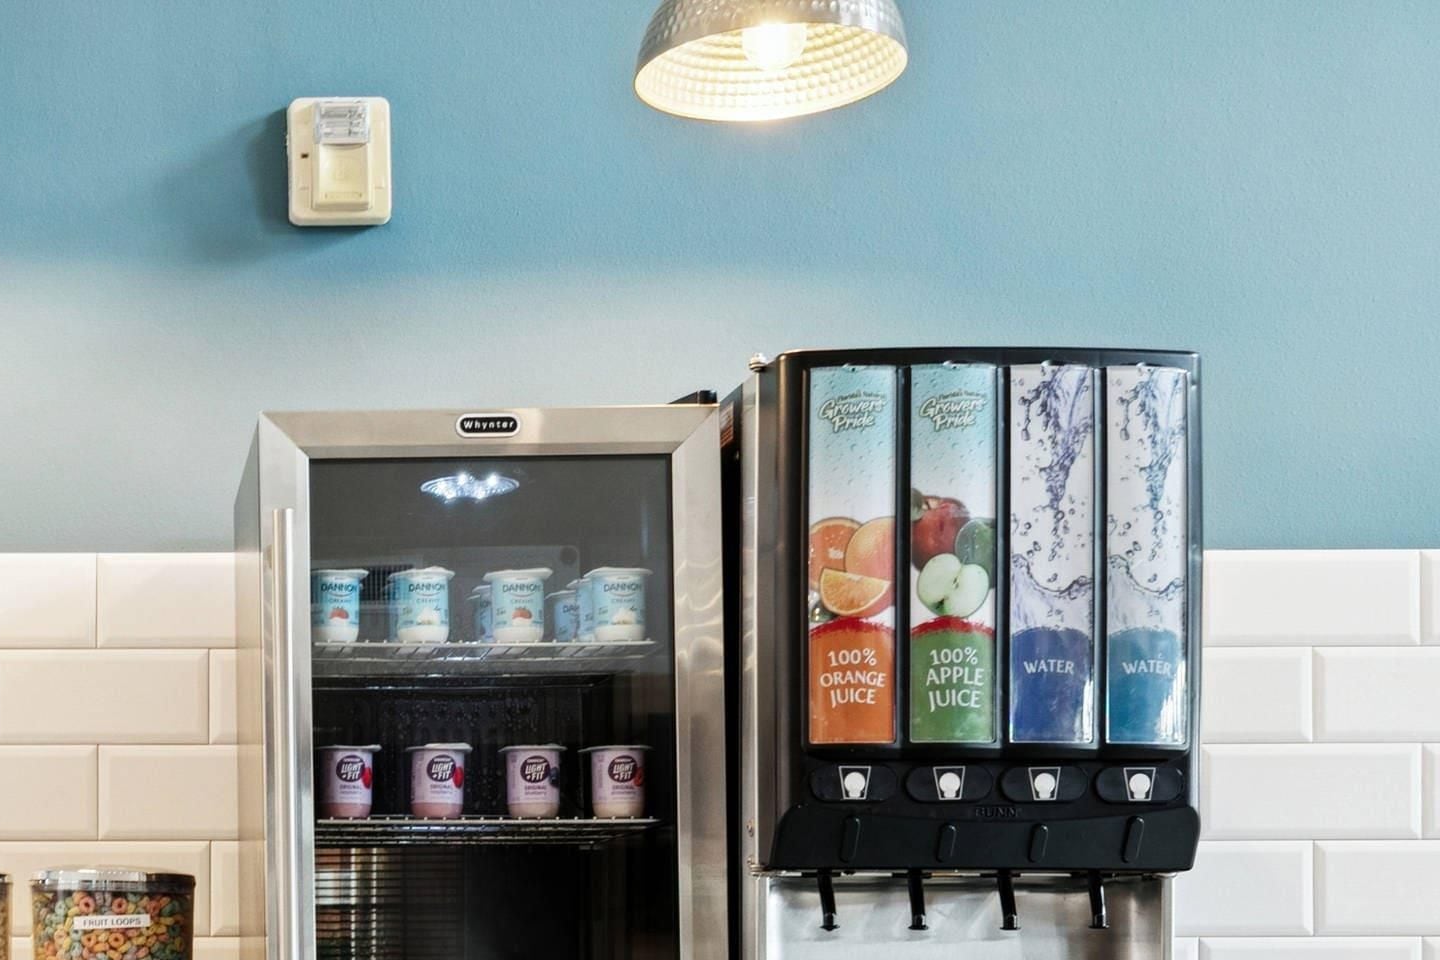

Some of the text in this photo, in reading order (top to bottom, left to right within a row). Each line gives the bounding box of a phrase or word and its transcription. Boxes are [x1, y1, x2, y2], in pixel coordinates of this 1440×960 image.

[831, 411, 875, 432] Pride
[932, 410, 976, 431] Pride
[827, 647, 878, 667] 100%
[929, 646, 979, 666] 100%
[926, 666, 985, 686] APPLE
[1023, 659, 1074, 675] WATER
[1121, 659, 1174, 676] WATER
[819, 671, 887, 688] ORANGE
[830, 688, 877, 708] JUICE
[928, 689, 982, 712] JUICE
[83, 917, 142, 928] FRUIT LOOPS
